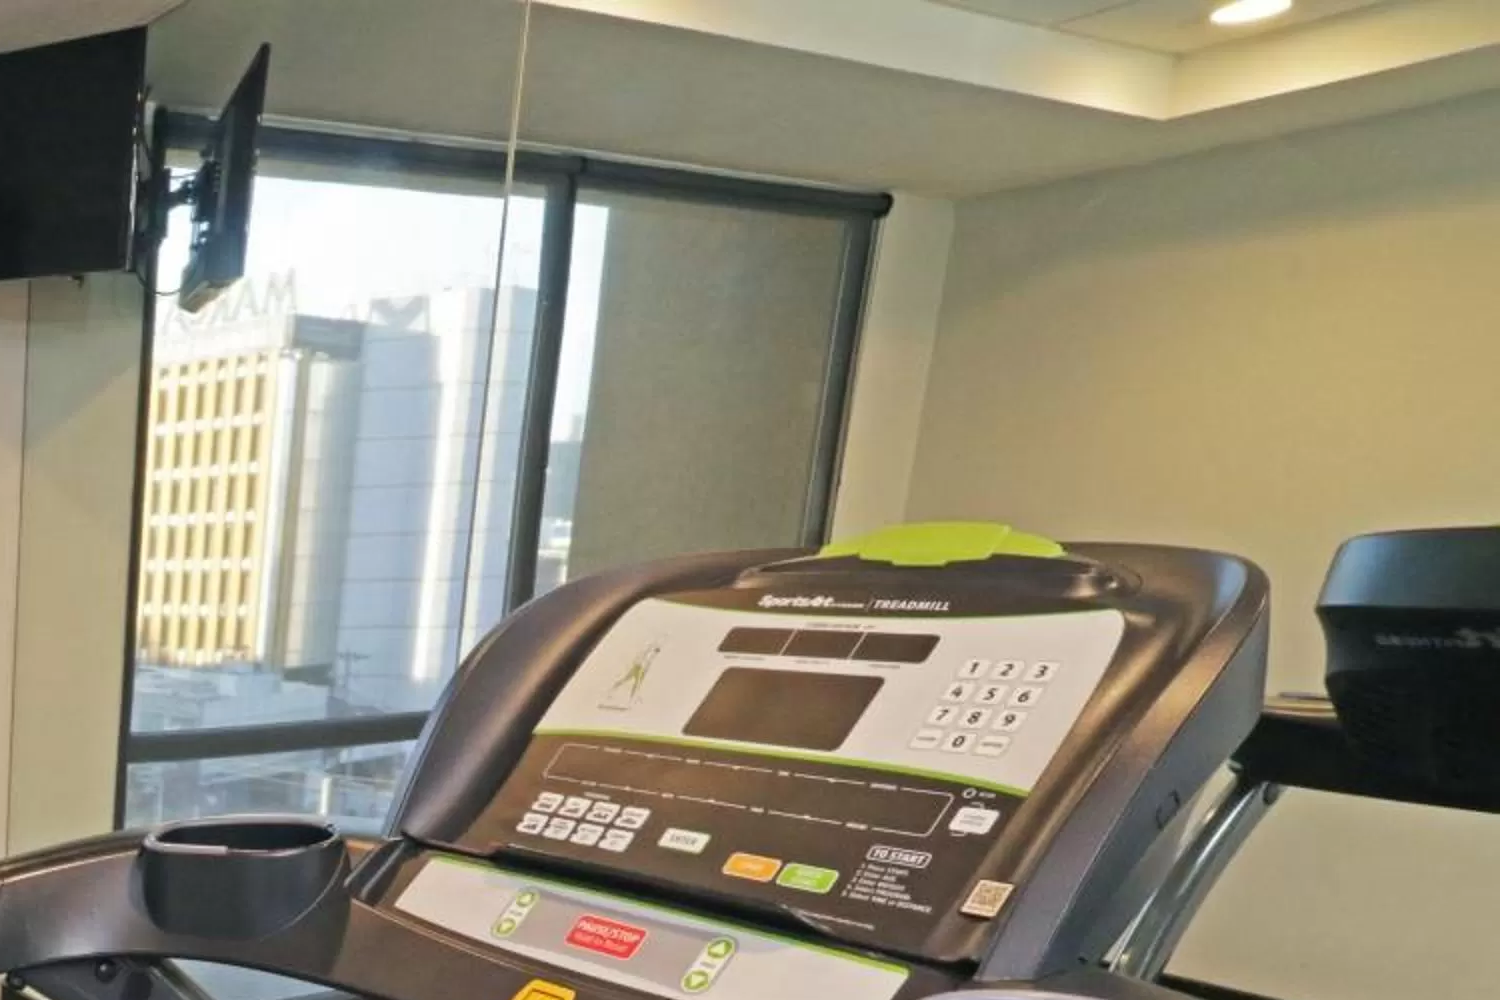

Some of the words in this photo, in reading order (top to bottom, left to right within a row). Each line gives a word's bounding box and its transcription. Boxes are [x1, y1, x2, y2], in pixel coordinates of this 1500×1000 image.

[873, 598, 949, 612] TREADMILL
[969, 661, 980, 675] 1
[999, 663, 1015, 677] 2
[1034, 664, 1049, 679] 3
[950, 685, 964, 698] 4
[982, 687, 999, 701] 5
[1017, 690, 1033, 703] 6
[935, 708, 950, 721] 7
[966, 711, 983, 725] 8
[1002, 713, 1017, 727] 9
[951, 735, 966, 748] 0
